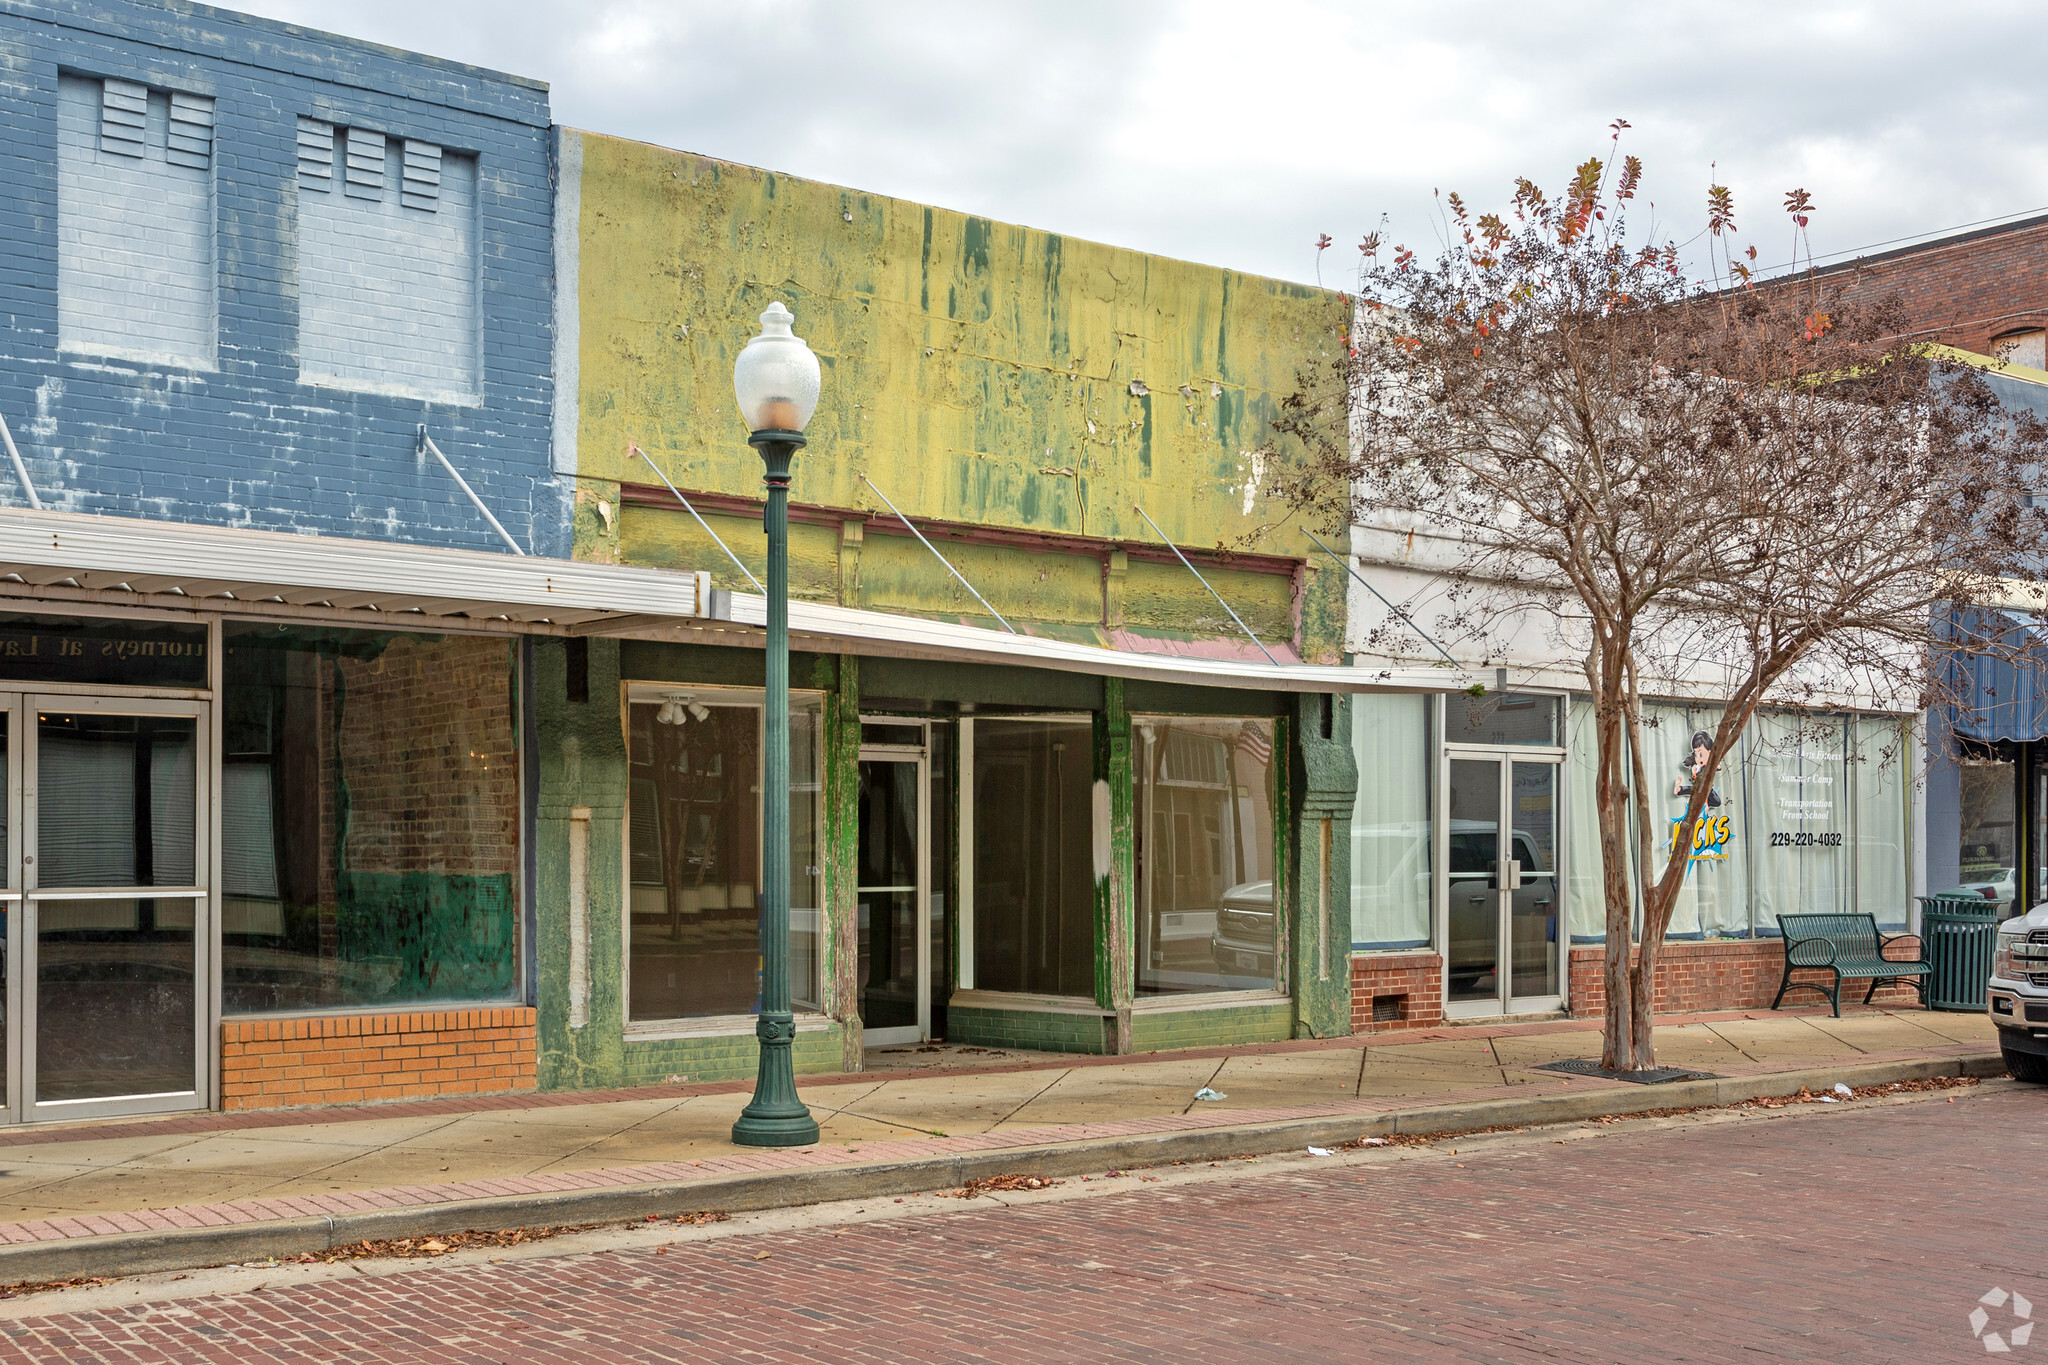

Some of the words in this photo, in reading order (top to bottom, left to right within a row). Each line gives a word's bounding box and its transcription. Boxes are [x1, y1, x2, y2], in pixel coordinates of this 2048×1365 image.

[1812, 774, 1833, 786] Camp
[1782, 810, 1802, 820] From
[1804, 810, 1829, 820] School
[1771, 832, 1842, 847] 229-220-4032
